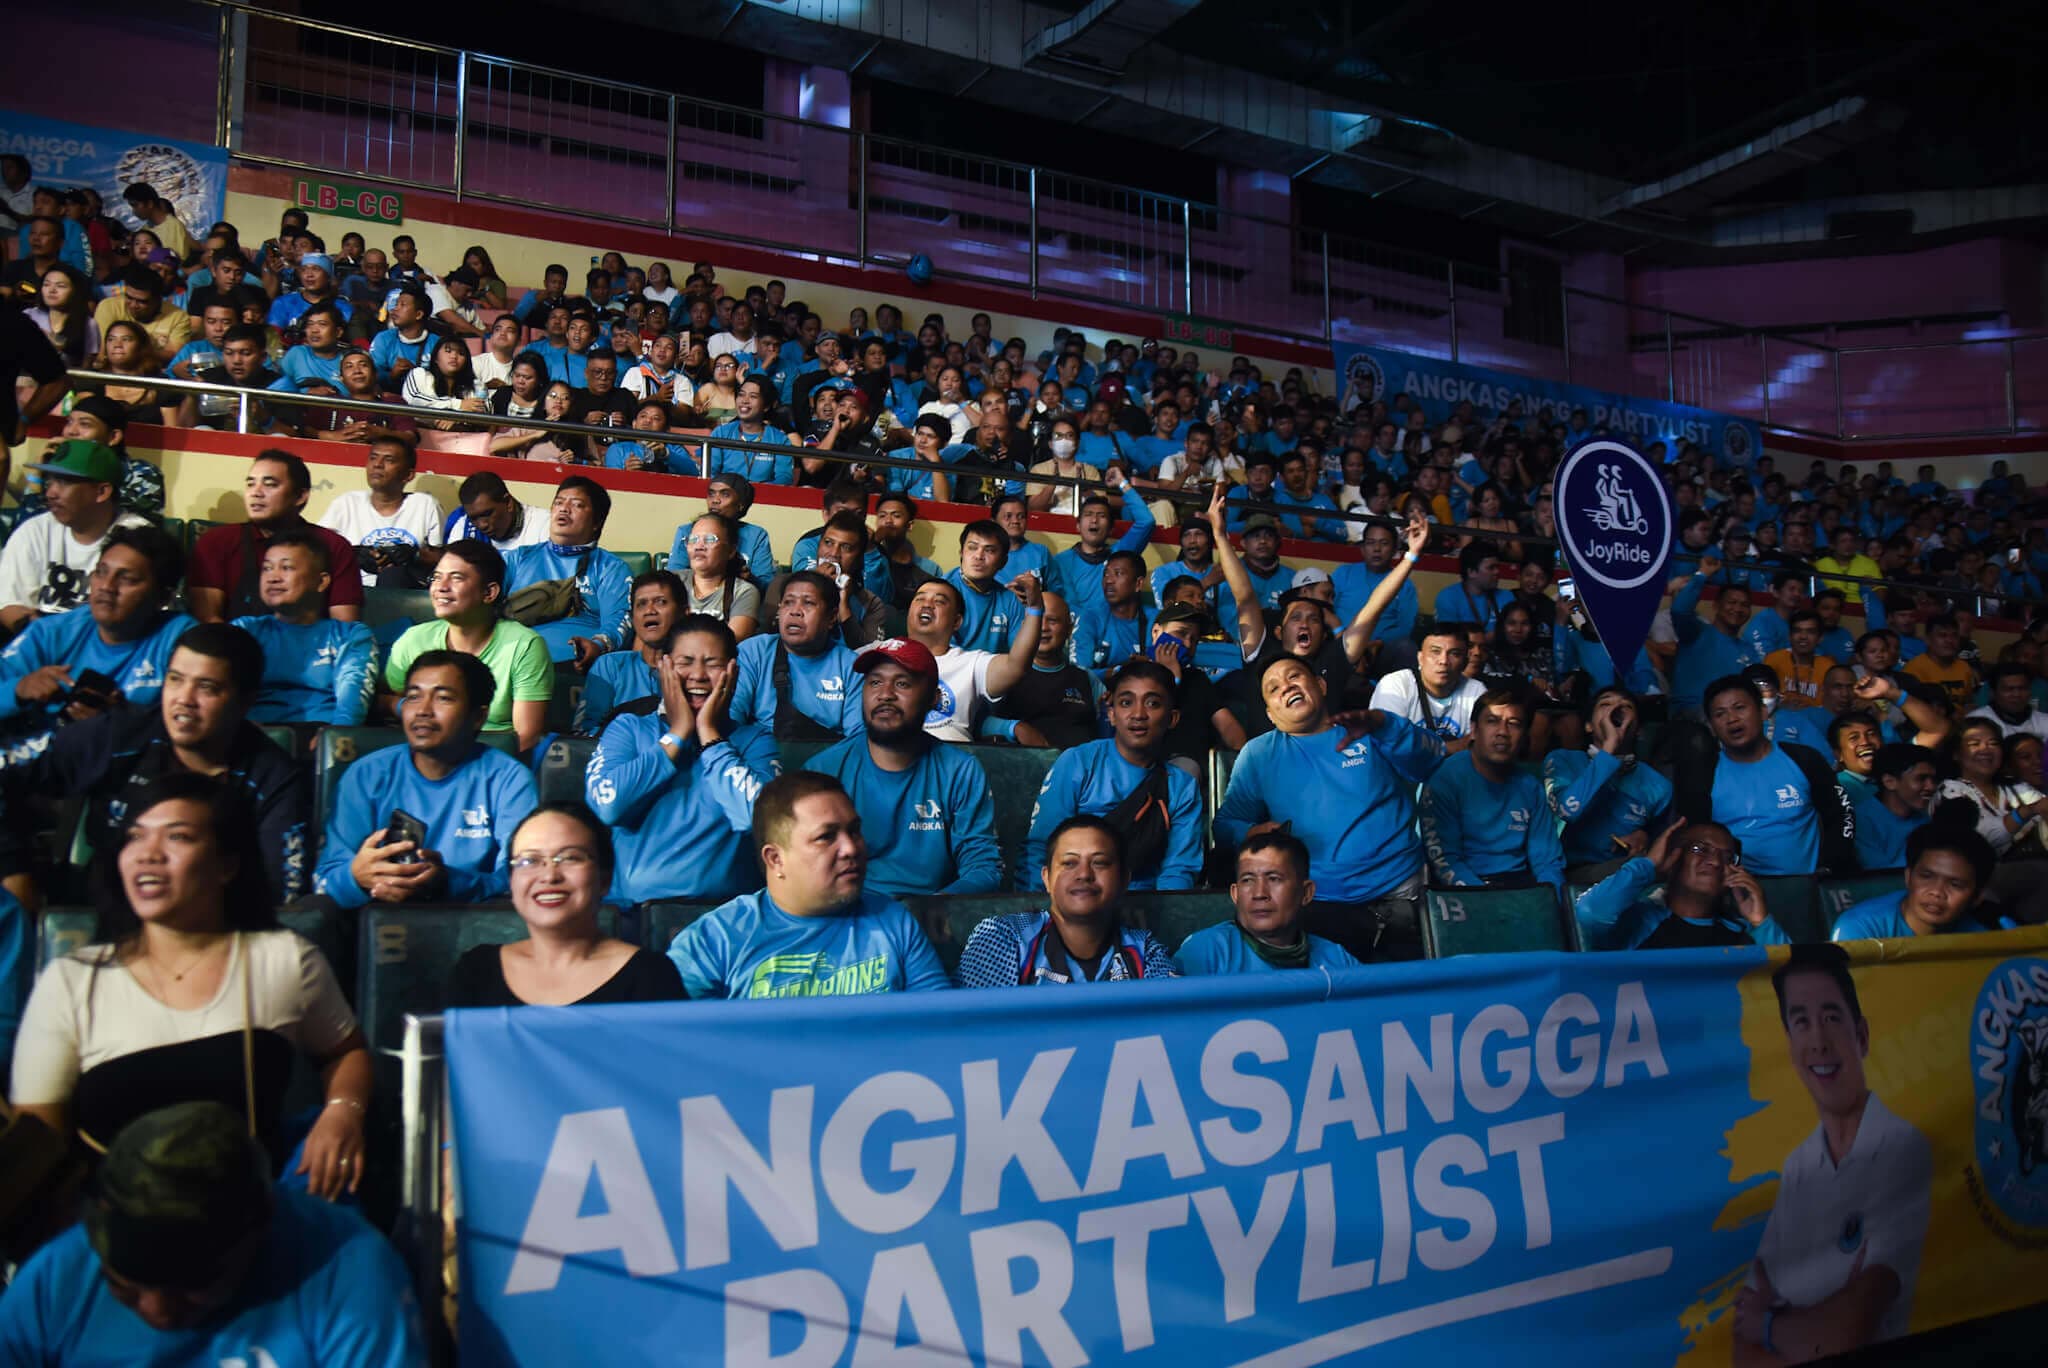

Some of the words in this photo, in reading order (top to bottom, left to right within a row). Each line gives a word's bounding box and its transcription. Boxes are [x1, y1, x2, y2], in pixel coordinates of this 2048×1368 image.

[298, 182, 399, 220] LB-CC
[1584, 538, 1651, 564] JoyRide
[1437, 896, 1468, 921] 13
[503, 980, 1670, 1296] ANGKASANGGA
